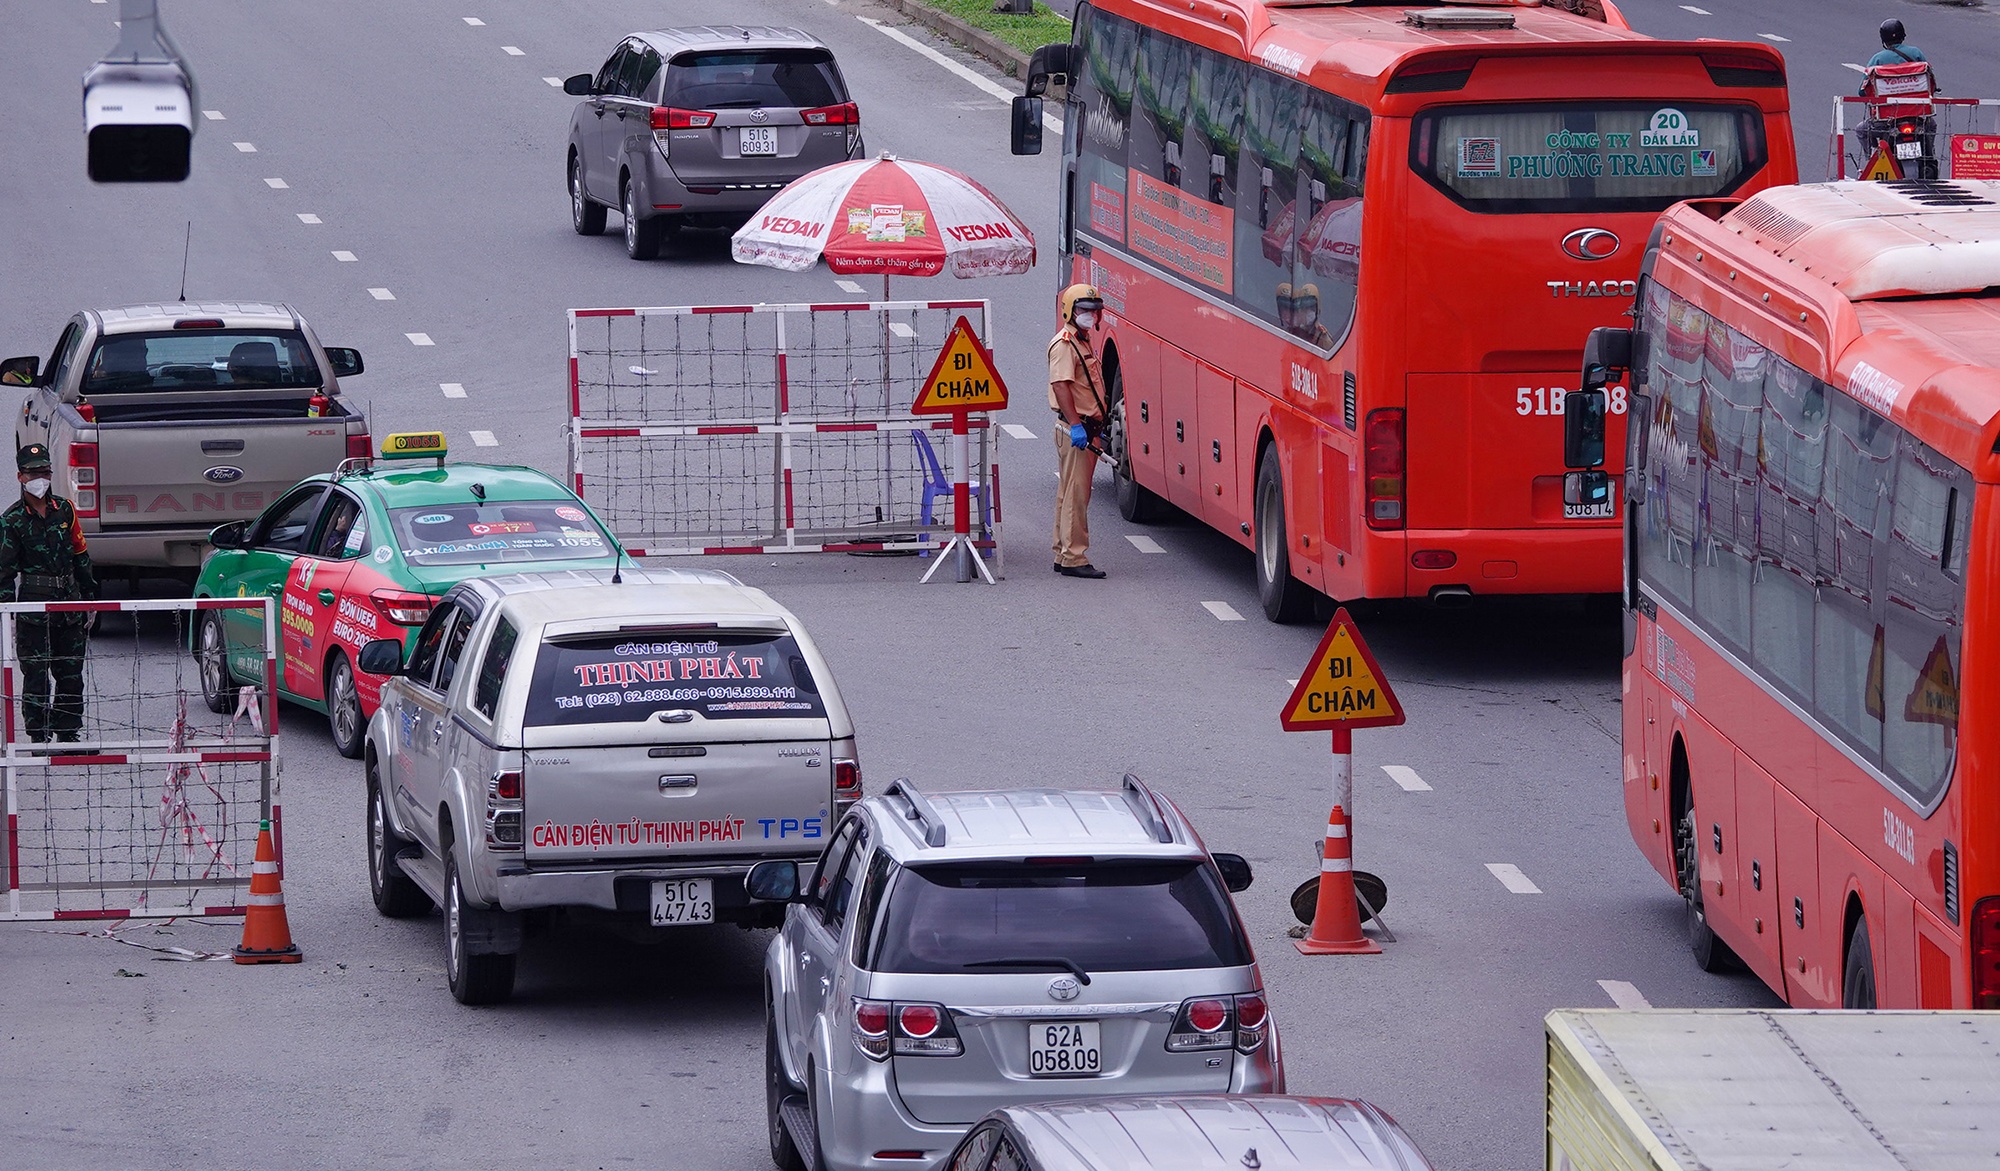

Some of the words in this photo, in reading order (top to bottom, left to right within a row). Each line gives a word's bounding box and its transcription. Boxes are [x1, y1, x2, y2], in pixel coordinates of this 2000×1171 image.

[1657, 113, 1680, 130] 20
[749, 129, 769, 141] 51G
[1545, 128, 1602, 149] CÔNG
[1605, 133, 1632, 149] TY
[1642, 131, 1669, 146] ĐẮK
[1672, 131, 1696, 146] LẮK
[742, 141, 775, 153] 609.31
[1507, 151, 1602, 178] PHƯƠNG
[1607, 153, 1687, 177] TRANG
[761, 216, 825, 239] VEDAN
[947, 222, 1014, 242] VEDAN
[836, 256, 854, 266] Nêm
[855, 256, 872, 267] đậm
[887, 258, 907, 266] thêm
[908, 258, 923, 270] gắn
[924, 261, 936, 269] bó
[1546, 280, 1637, 297] THACO
[953, 352, 972, 370] ĐI
[936, 377, 990, 400] CHẬM
[406, 435, 440, 449] 1055
[212, 468, 236, 480] Ford
[106, 490, 283, 514] RANG
[557, 538, 604, 548] 1055
[286, 592, 298, 610] TRỌN
[298, 598, 306, 614] BỘ
[339, 598, 356, 618] ĐÓN
[356, 608, 377, 630] UEFA
[333, 620, 354, 642] EURO
[614, 642, 648, 656] CÂN
[651, 641, 693, 655] ĐIỆN
[694, 640, 719, 654] TỬ
[574, 658, 676, 688] THỊNH
[679, 651, 764, 680] PHÁT
[1328, 656, 1352, 679] ĐI
[555, 696, 583, 709] Tel:
[585, 692, 622, 708] (028)
[1308, 686, 1375, 716] CHẬM
[778, 747, 821, 757] HILUX
[532, 819, 568, 848] CÂN
[572, 818, 614, 850] ĐIỆN
[616, 816, 640, 844] TỬ
[643, 820, 696, 849] THỊNH
[698, 814, 746, 842] PHÁT
[757, 816, 823, 840] TPS
[665, 881, 698, 902] 51C
[653, 902, 712, 924] 447.43
[991, 1004, 1140, 1016] FORTUNER
[1045, 1025, 1084, 1048] 62A
[1031, 1048, 1099, 1072] 058.09
[1205, 1057, 1223, 1068] G
